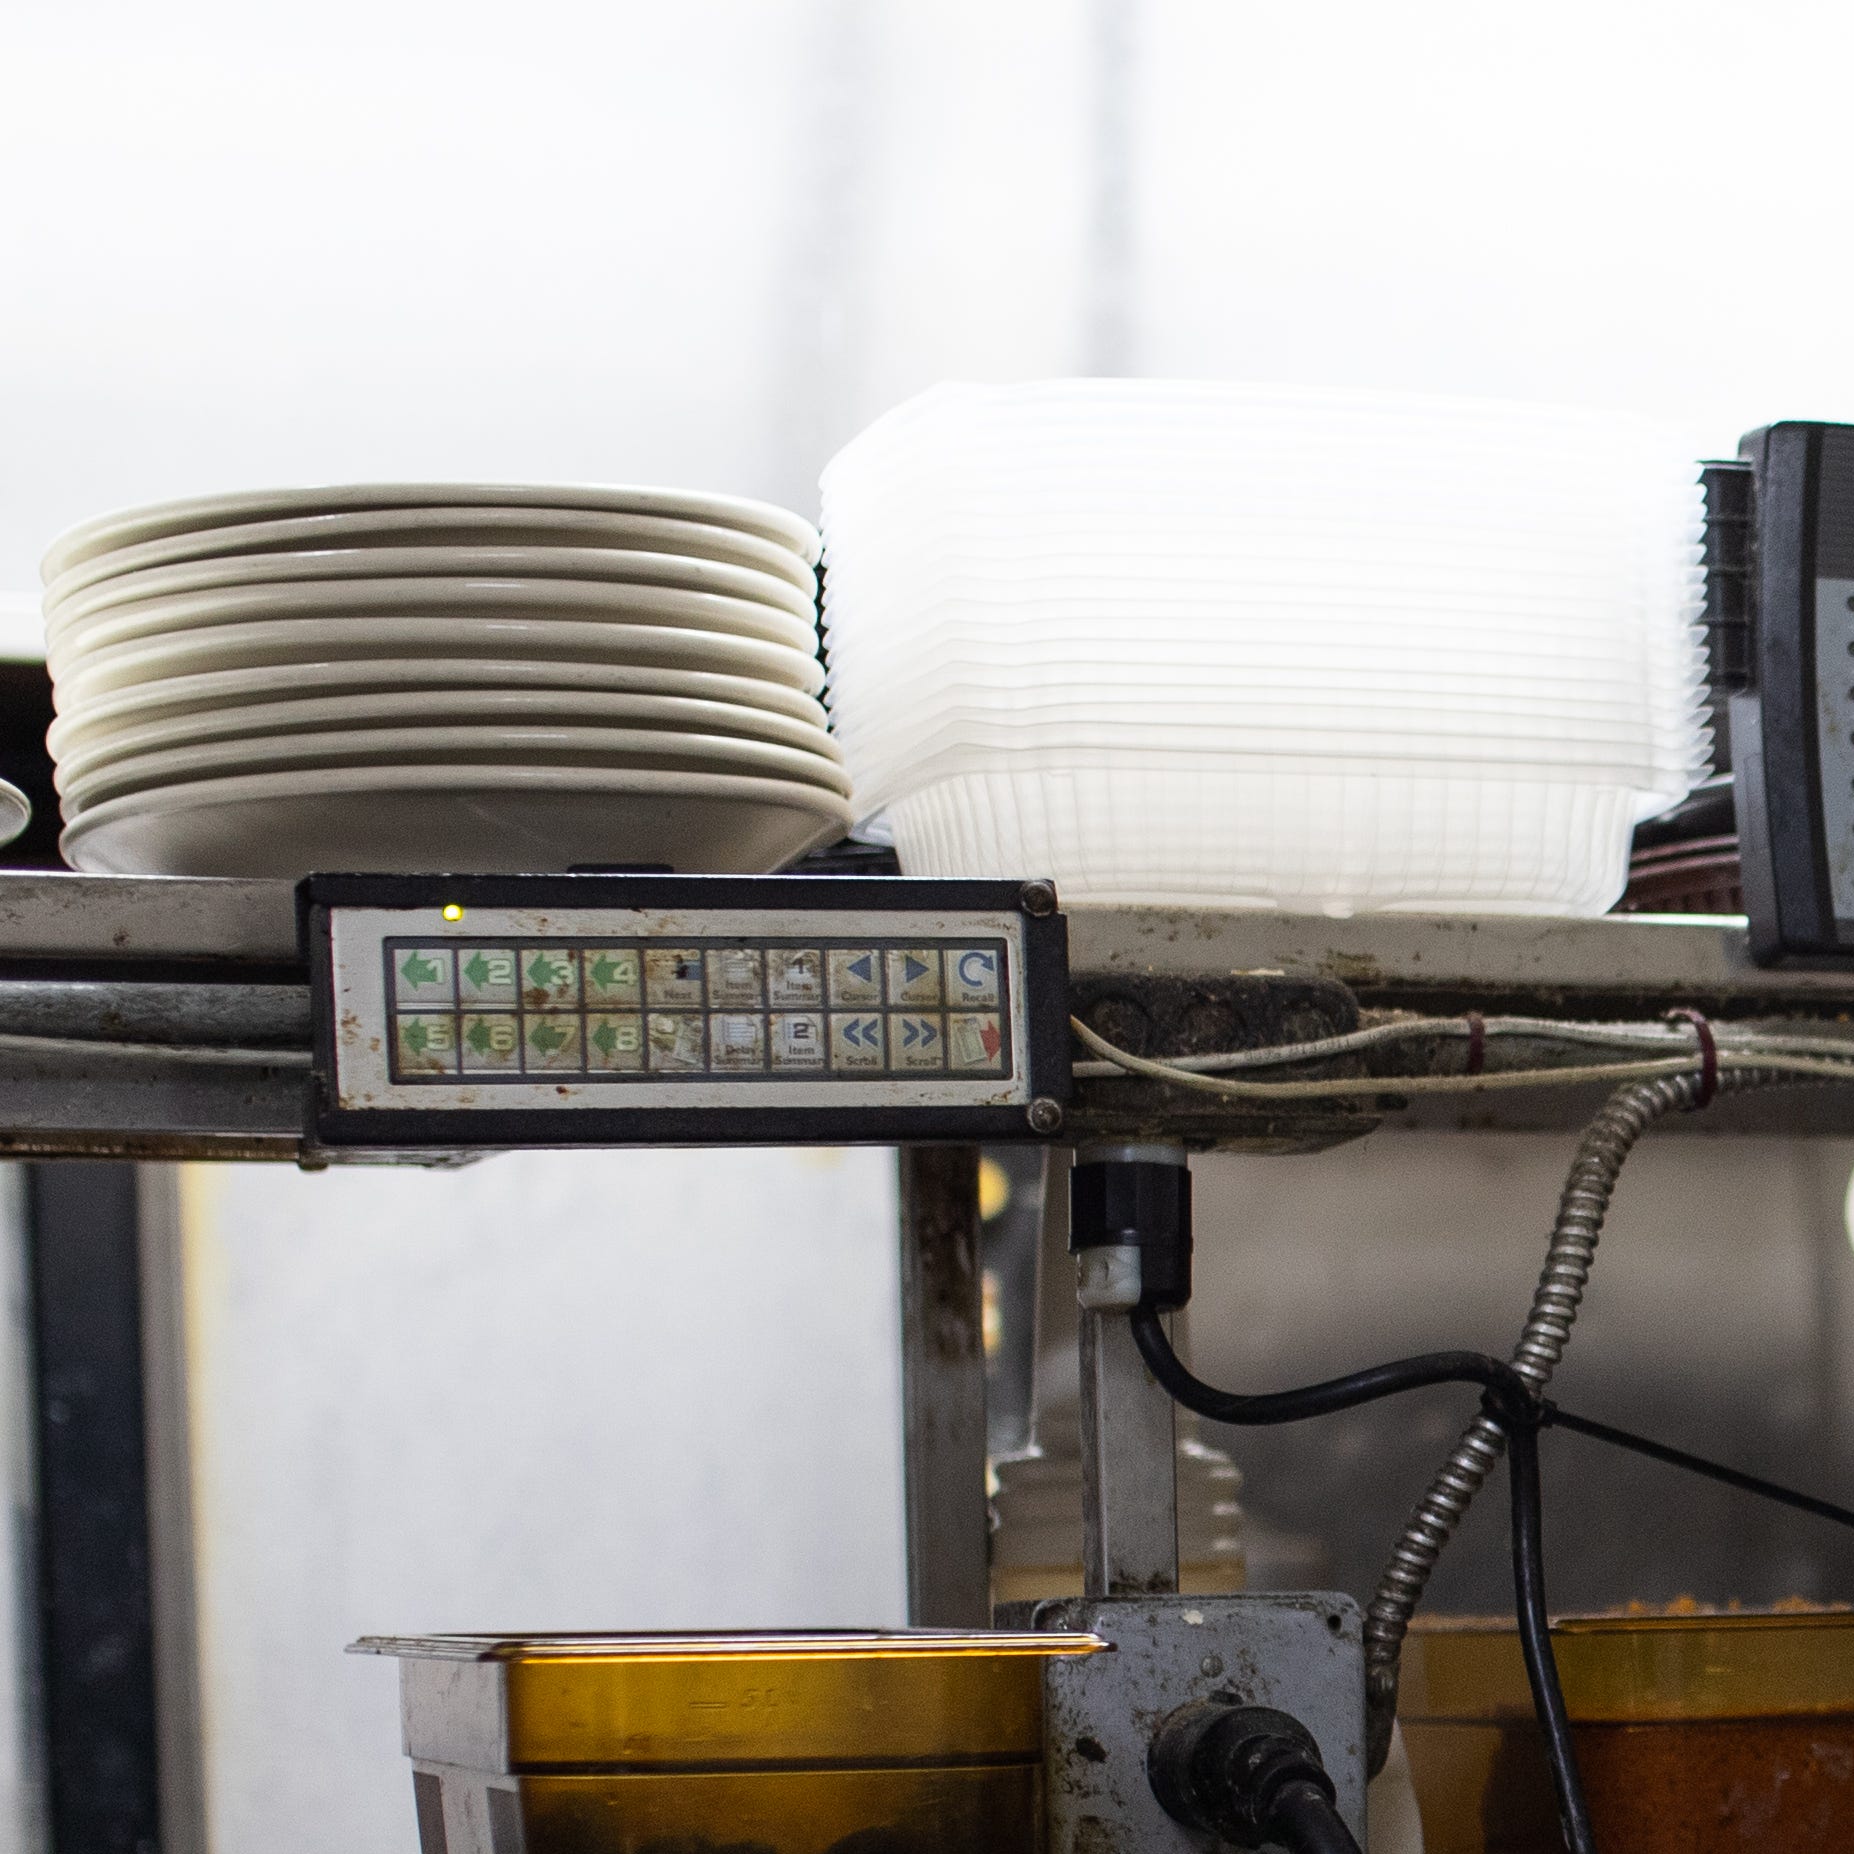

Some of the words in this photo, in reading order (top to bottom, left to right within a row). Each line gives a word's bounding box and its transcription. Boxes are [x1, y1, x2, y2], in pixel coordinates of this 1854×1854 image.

[426, 957, 445, 984] 1
[487, 958, 512, 986] 2
[551, 958, 575, 986] 3
[613, 961, 637, 986] 4
[426, 1025, 448, 1050] 5
[489, 1025, 513, 1050] 6
[550, 1025, 575, 1050] 7
[616, 1026, 639, 1050] 8
[793, 1022, 810, 1039] 2
